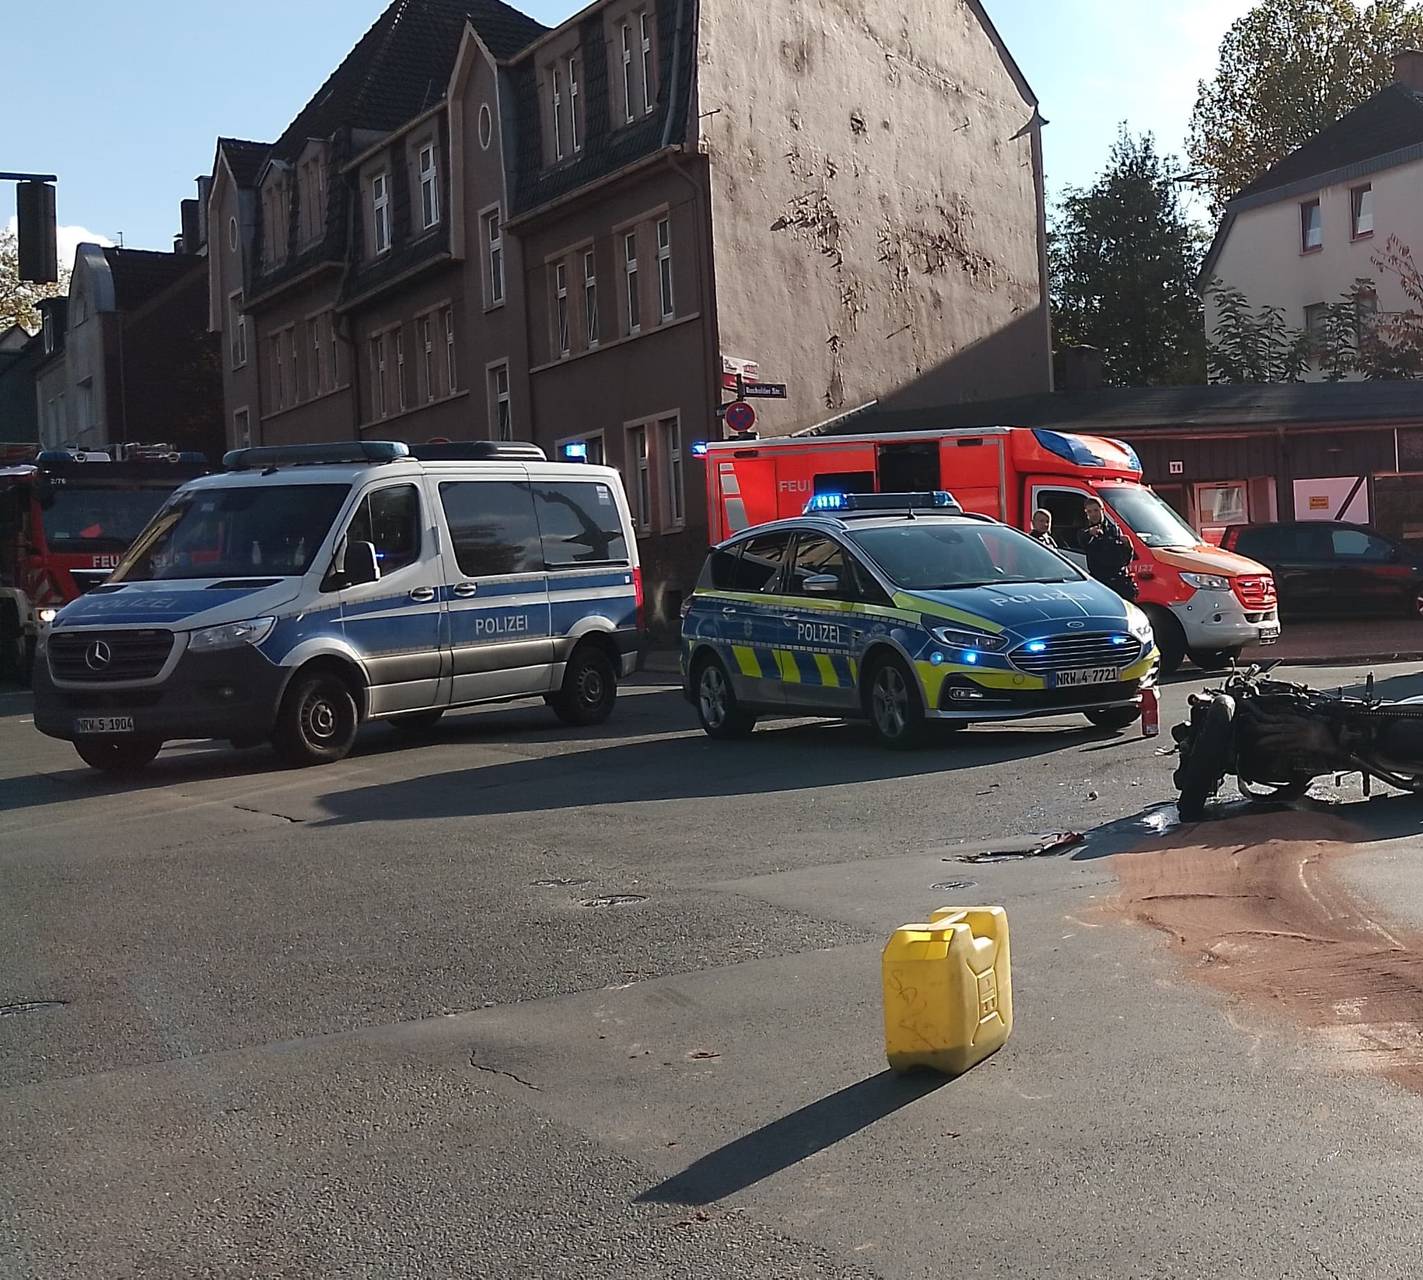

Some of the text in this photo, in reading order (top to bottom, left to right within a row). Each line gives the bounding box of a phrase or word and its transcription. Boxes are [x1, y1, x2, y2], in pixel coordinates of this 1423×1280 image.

[990, 591, 1095, 607] POLIZEI
[475, 614, 529, 635] POLIZEI
[797, 623, 841, 644] POLIZEI
[1056, 671, 1077, 686] NRW
